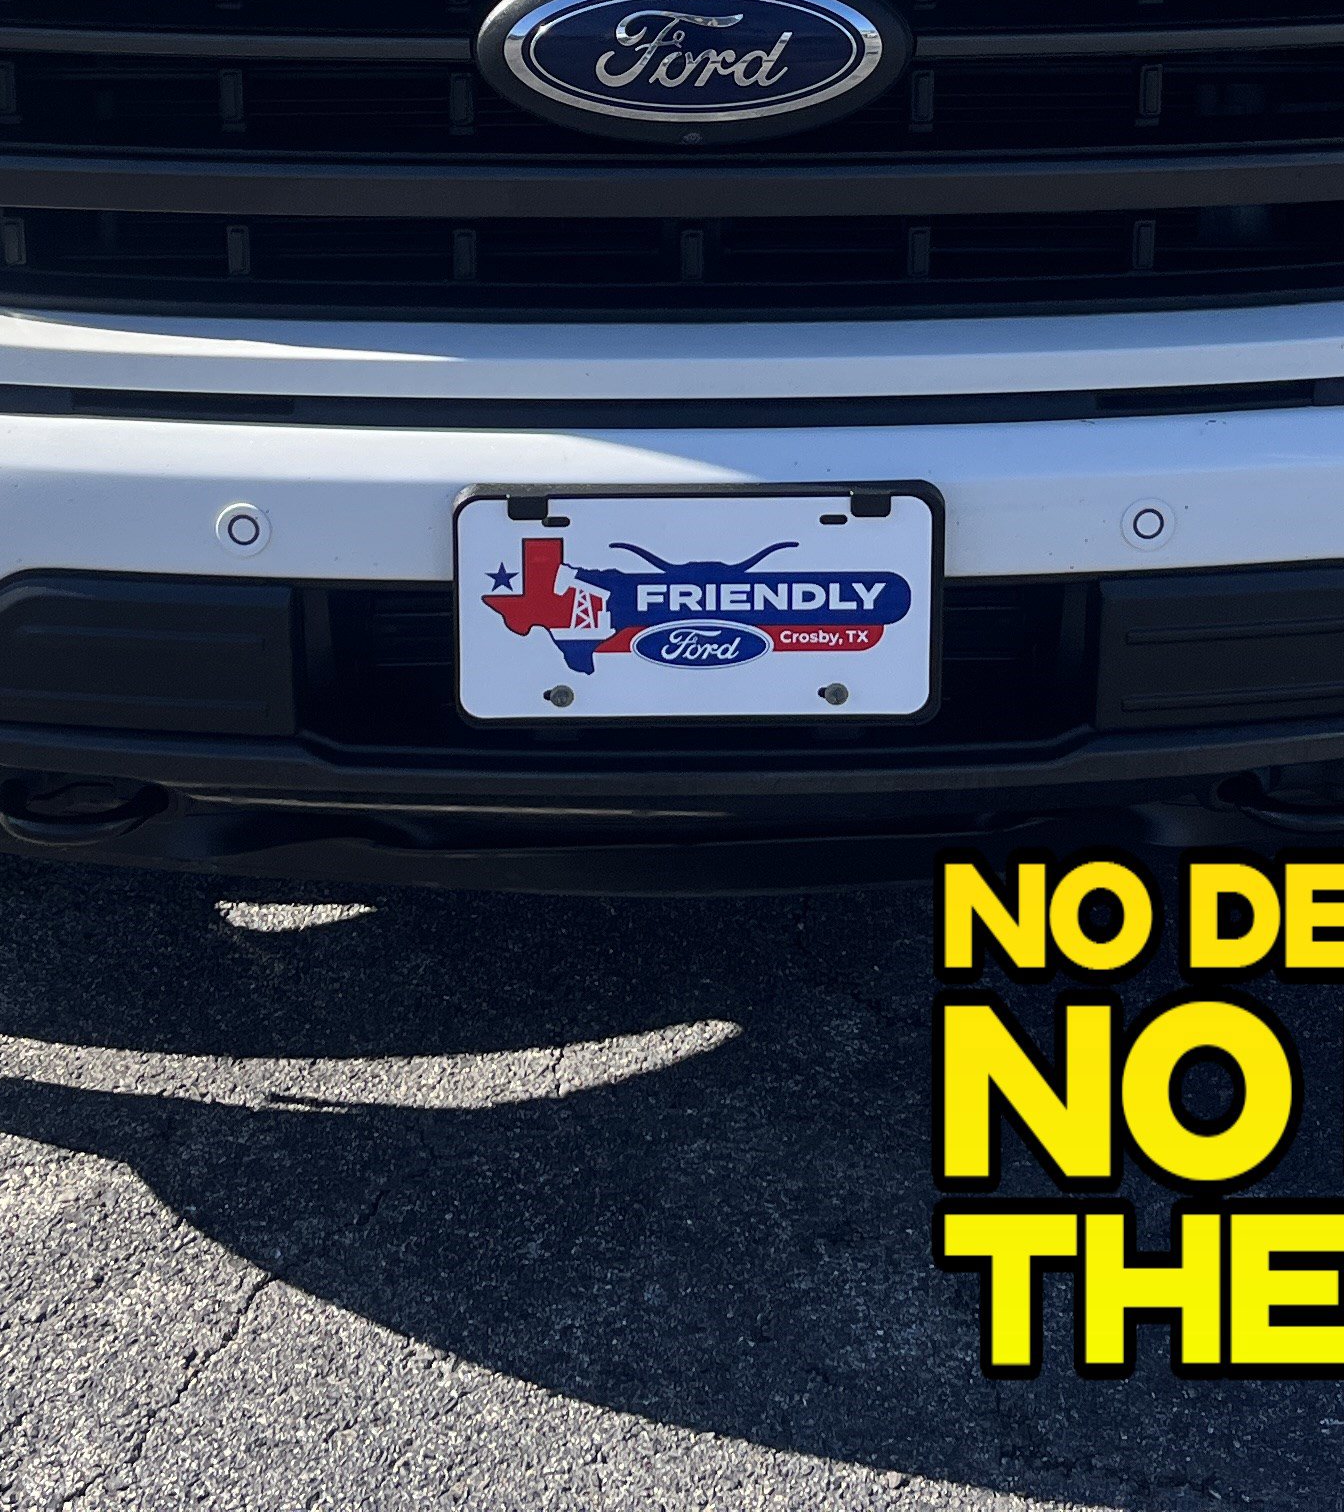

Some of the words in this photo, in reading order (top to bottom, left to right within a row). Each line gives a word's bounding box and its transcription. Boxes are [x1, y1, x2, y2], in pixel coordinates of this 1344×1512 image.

[595, 9, 793, 88] Ford
[637, 582, 886, 611] FRIENDLY
[661, 628, 740, 660] Ford
[779, 631, 844, 646] Crosby,
[846, 630, 869, 645] TX
